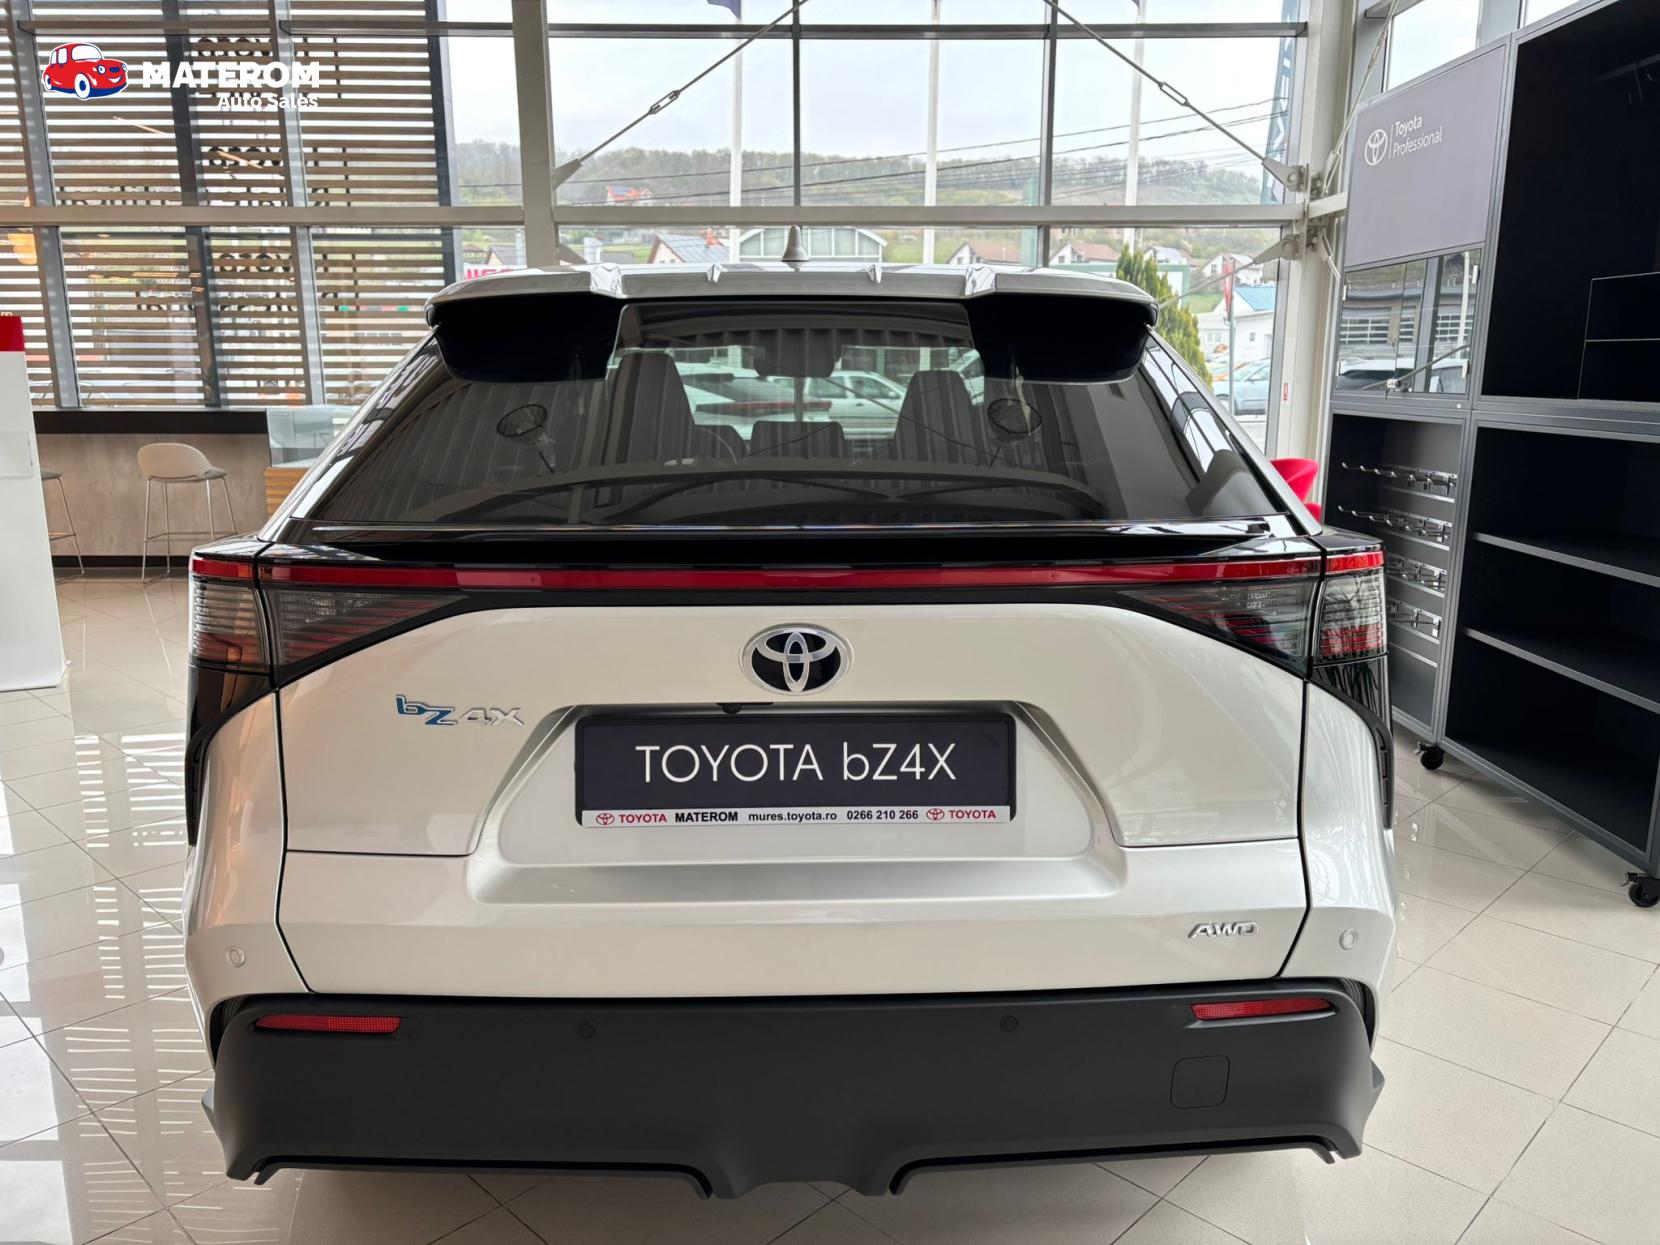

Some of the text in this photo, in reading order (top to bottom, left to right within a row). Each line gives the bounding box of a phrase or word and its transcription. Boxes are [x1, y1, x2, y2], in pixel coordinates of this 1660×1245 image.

[1395, 115, 1423, 138] Toyota
[1393, 125, 1443, 159] Professional
[635, 741, 957, 783] TOYOTA bZ4X
[618, 808, 997, 824] TOYOTA MATEROM mures.toyota.ro 0266 210 266 TOYOTA
[1187, 921, 1258, 938] AWD
